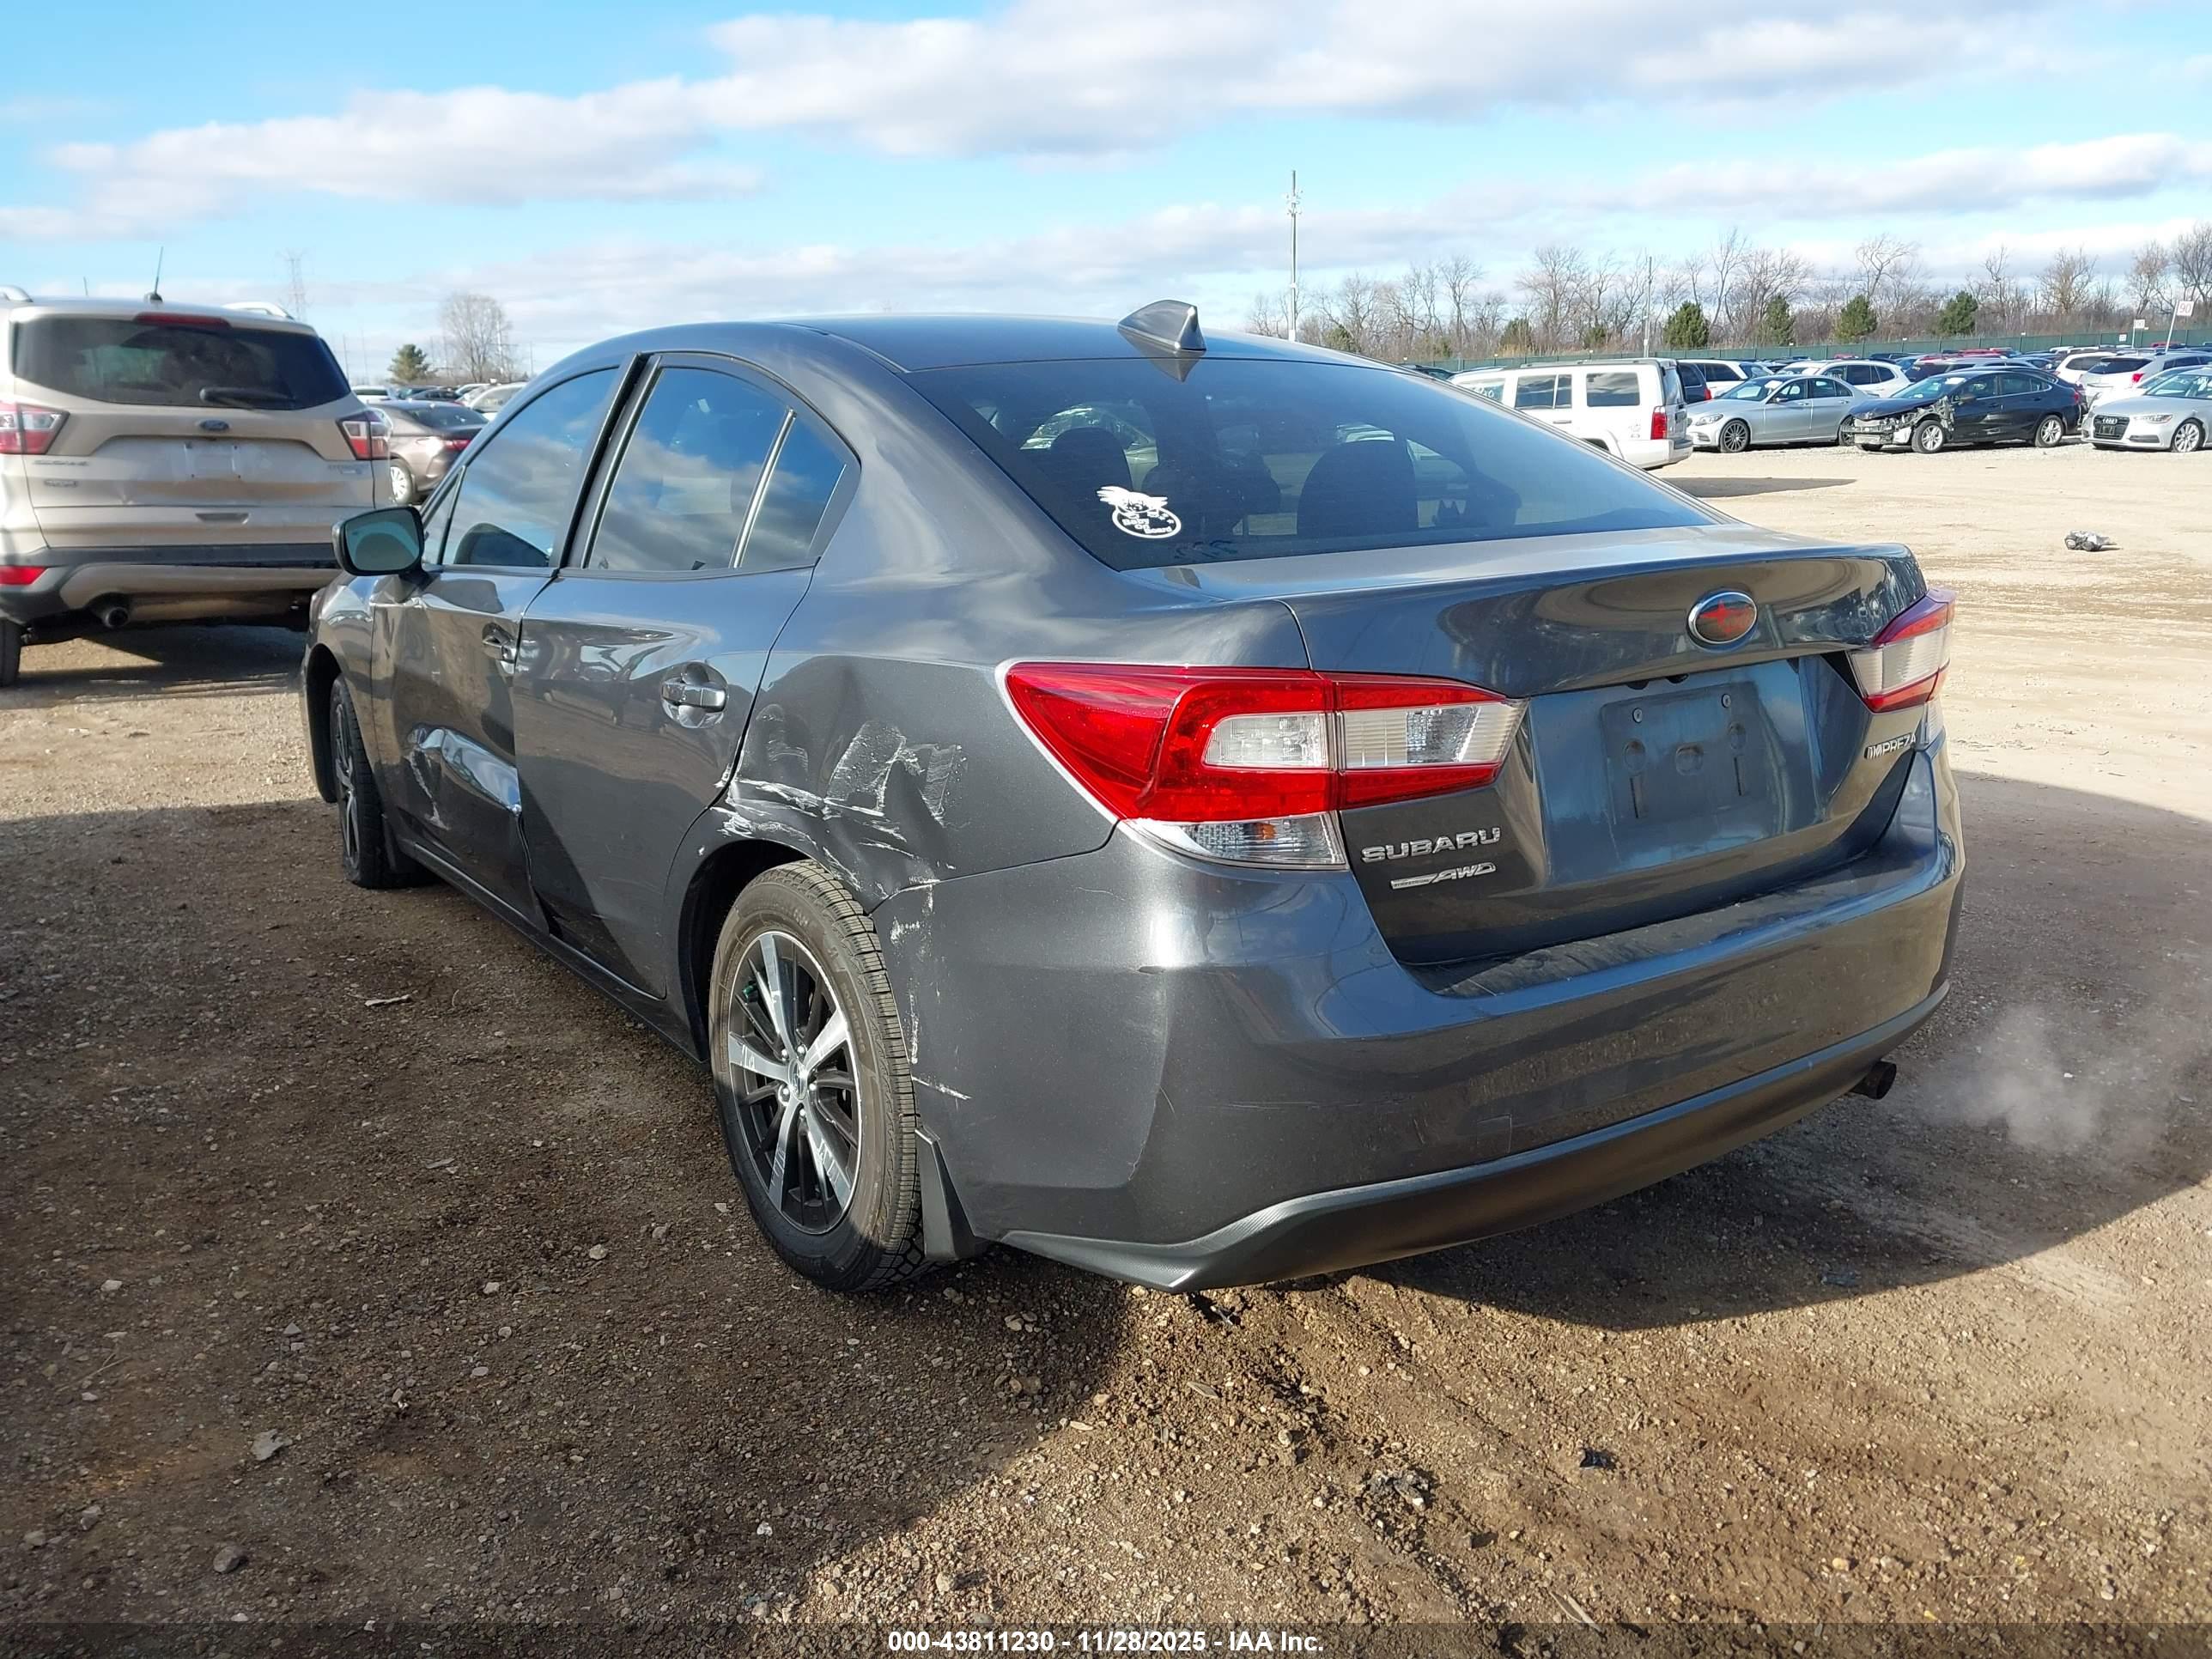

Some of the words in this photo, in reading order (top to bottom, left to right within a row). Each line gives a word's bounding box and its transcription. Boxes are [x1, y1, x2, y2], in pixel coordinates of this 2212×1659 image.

[2179, 302, 2191, 314] 90
[1121, 518, 1150, 526] Baby
[1865, 732, 1917, 760] IMPREZA
[1361, 827, 1501, 863] SUBARU
[1431, 861, 1497, 884] AWD
